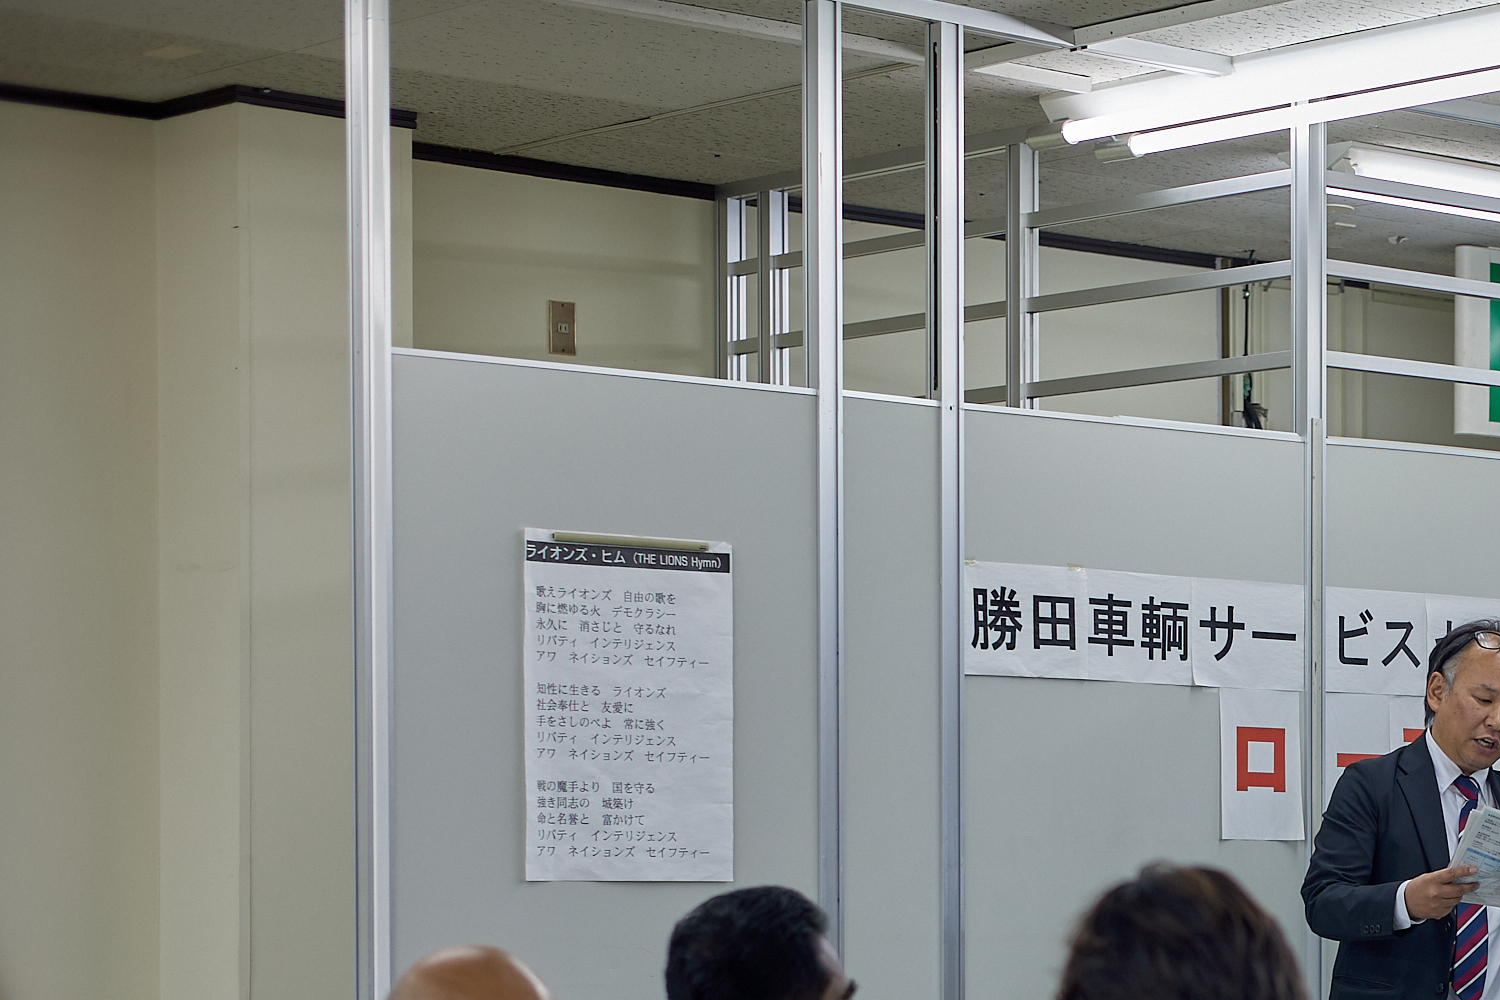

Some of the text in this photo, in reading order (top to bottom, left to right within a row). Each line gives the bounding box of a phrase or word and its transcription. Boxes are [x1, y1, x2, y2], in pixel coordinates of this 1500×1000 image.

[526, 544, 626, 564] ライオンズ・ヒム
[660, 555, 688, 567] LIONS
[691, 557, 722, 570] Hymn)
[536, 586, 676, 604] 歌えライオンズ 自由の歌を
[613, 608, 675, 619] デモクラシー
[536, 618, 676, 635] 永久に 消さじと 守るなれ
[538, 635, 675, 651] リバティ インテリジェンス
[537, 651, 709, 668] アワ ネイションズ セイフティー
[537, 683, 666, 698] 知性に生きる ライオンズ
[537, 699, 633, 714] 社会奉仕と 友愛に
[537, 715, 663, 730] 手をさしのべよ 常に強く
[538, 732, 675, 746] リバティ インテリジェンス
[537, 748, 709, 763] アワ ネイションズ セイフティー
[613, 782, 654, 794] 国を守る
[538, 797, 633, 809] 強き同志の 城築け
[602, 814, 644, 825] 富かけて
[539, 829, 676, 841] リバティ インテリジェンス
[538, 846, 709, 858] アワ ネイションズ セイフティー
